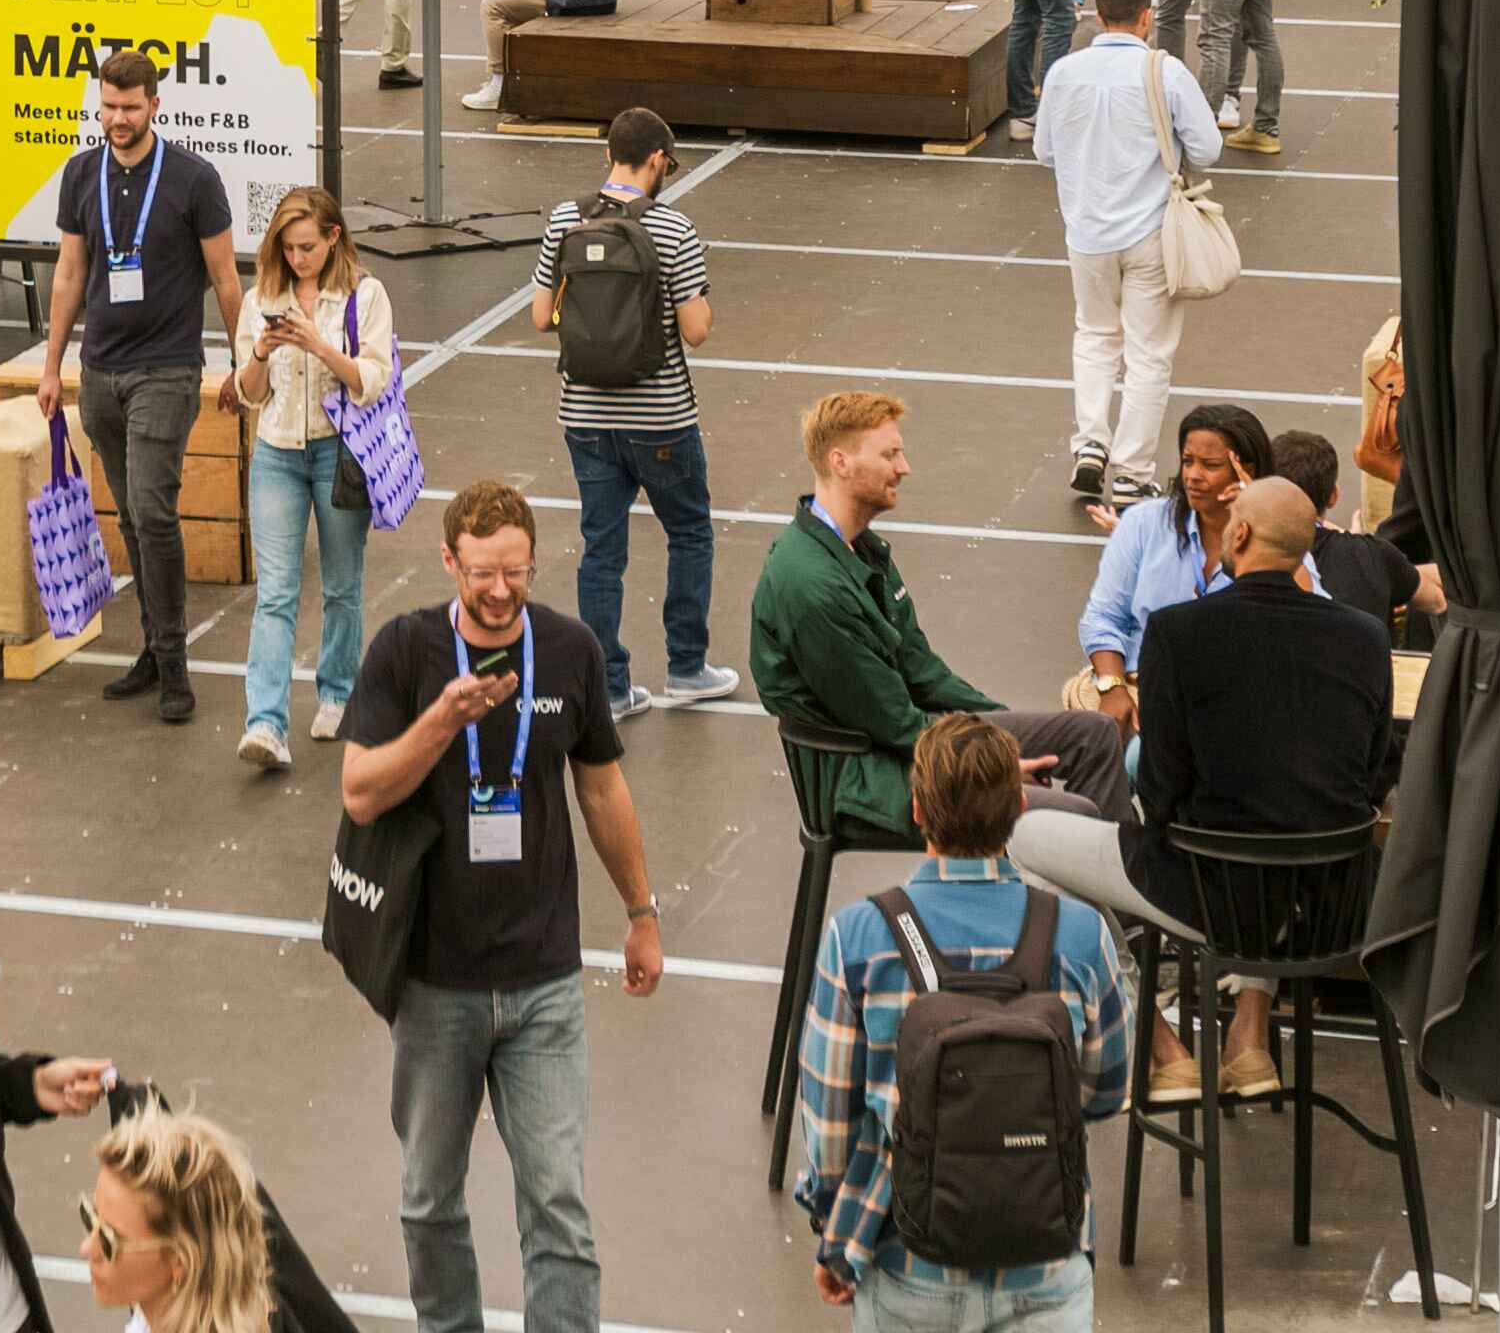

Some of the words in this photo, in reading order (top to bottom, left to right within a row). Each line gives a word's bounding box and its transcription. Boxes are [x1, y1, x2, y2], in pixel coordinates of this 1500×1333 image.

[14, 103, 62, 121] Meet
[66, 107, 90, 122] us
[174, 111, 206, 129] the
[210, 113, 251, 130] F&B
[14, 129, 81, 147] station
[243, 139, 293, 157] floor.
